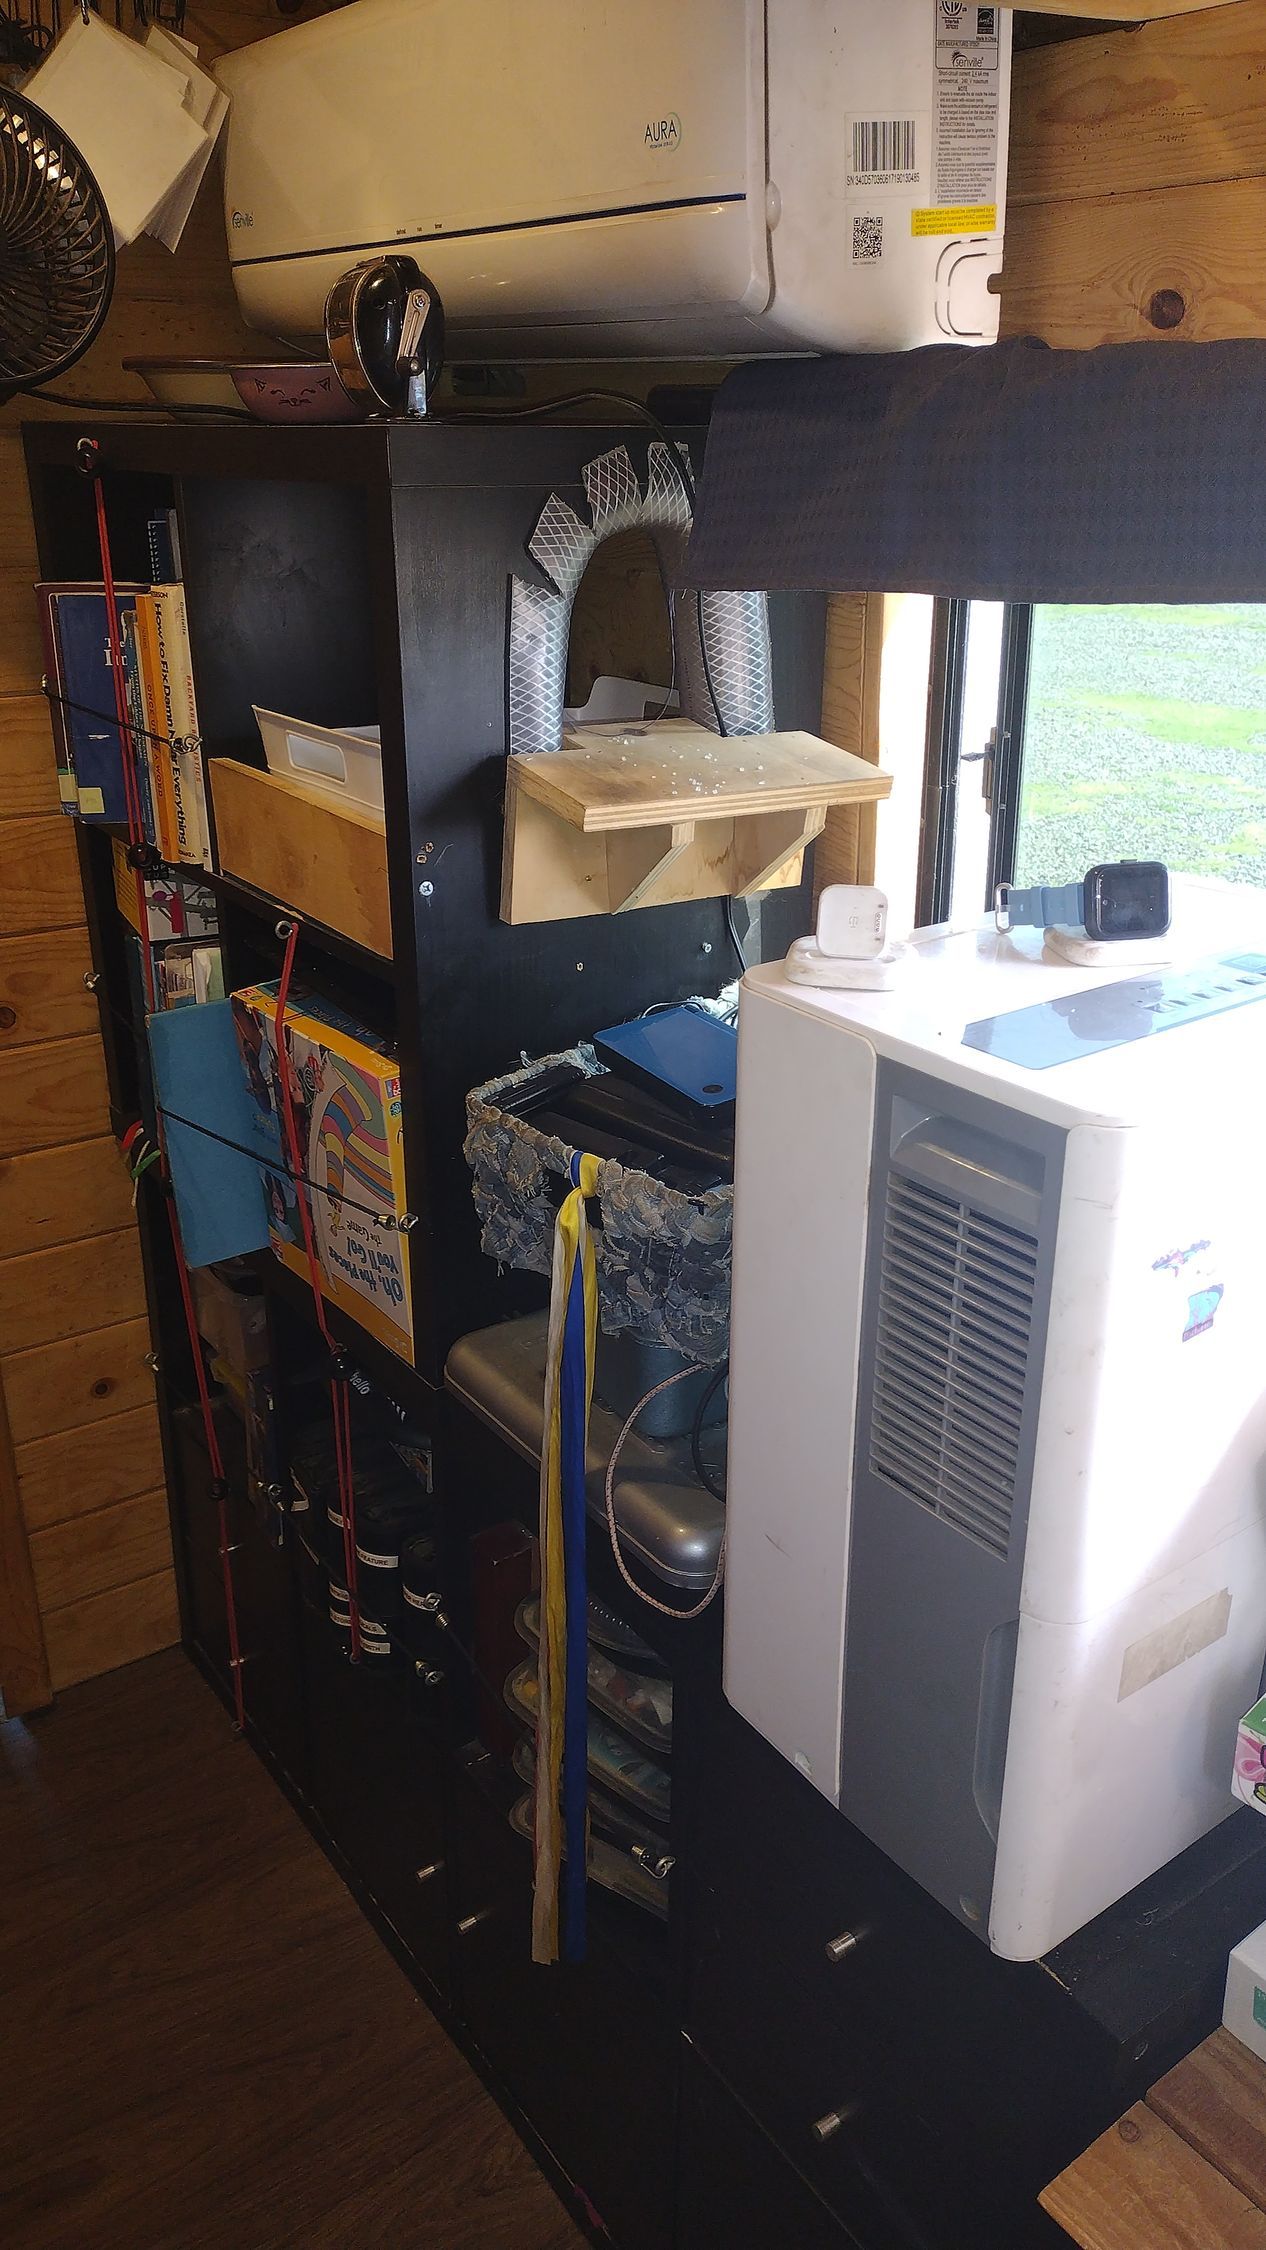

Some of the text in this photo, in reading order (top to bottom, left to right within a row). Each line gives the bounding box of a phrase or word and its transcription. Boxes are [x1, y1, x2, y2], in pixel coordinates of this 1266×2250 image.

[644, 119, 677, 144] AURA
[161, 660, 169, 684] Fix
[172, 766, 187, 846] Everything
[156, 765, 164, 797] WORD
[346, 1219, 370, 1242] Game
[346, 1236, 399, 1275] You'll Go!
[328, 1245, 404, 1306] Oh, the Places
